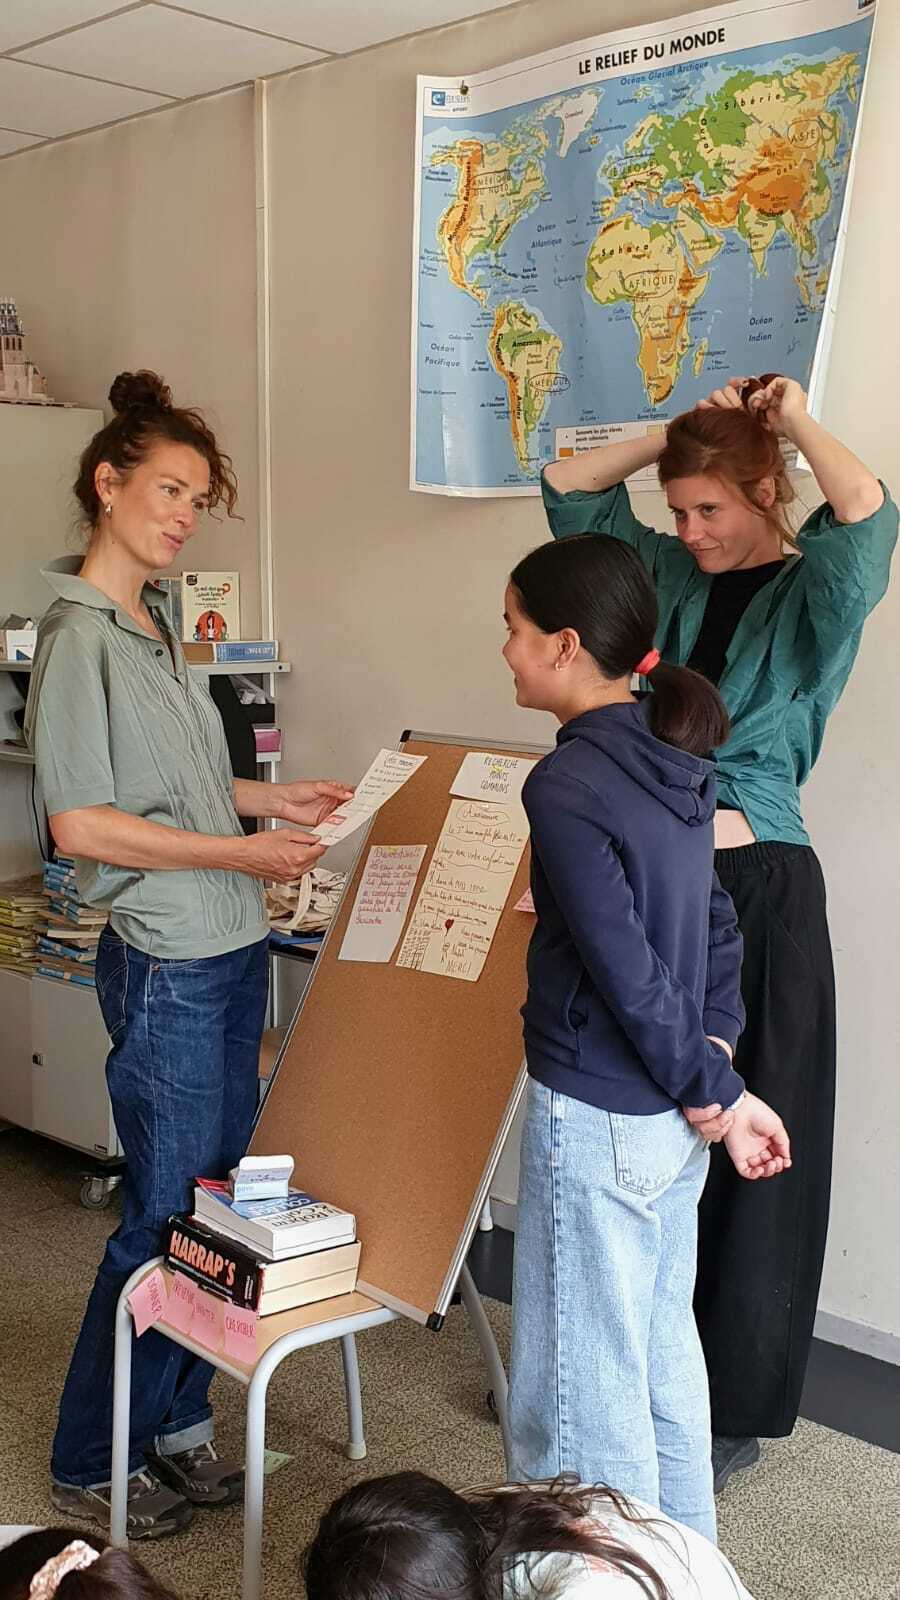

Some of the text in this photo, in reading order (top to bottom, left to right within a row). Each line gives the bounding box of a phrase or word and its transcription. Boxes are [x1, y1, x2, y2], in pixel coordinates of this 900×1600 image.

[579, 28, 725, 75] LE RELIEF DU MONDE
[648, 69, 676, 82] Glacial
[677, 61, 709, 74] Arctique
[724, 93, 780, 111] Sibérie
[790, 129, 816, 145] ASIE
[602, 243, 649, 257] Sahara
[629, 275, 674, 289] AFRIQUE
[749, 317, 773, 326] Océan
[430, 343, 455, 353] Océan
[424, 356, 461, 368] Pacifique
[484, 756, 518, 768] RECHERCHE
[480, 780, 510, 794] COMMUNS
[170, 1230, 236, 1286] HARRAP'S
